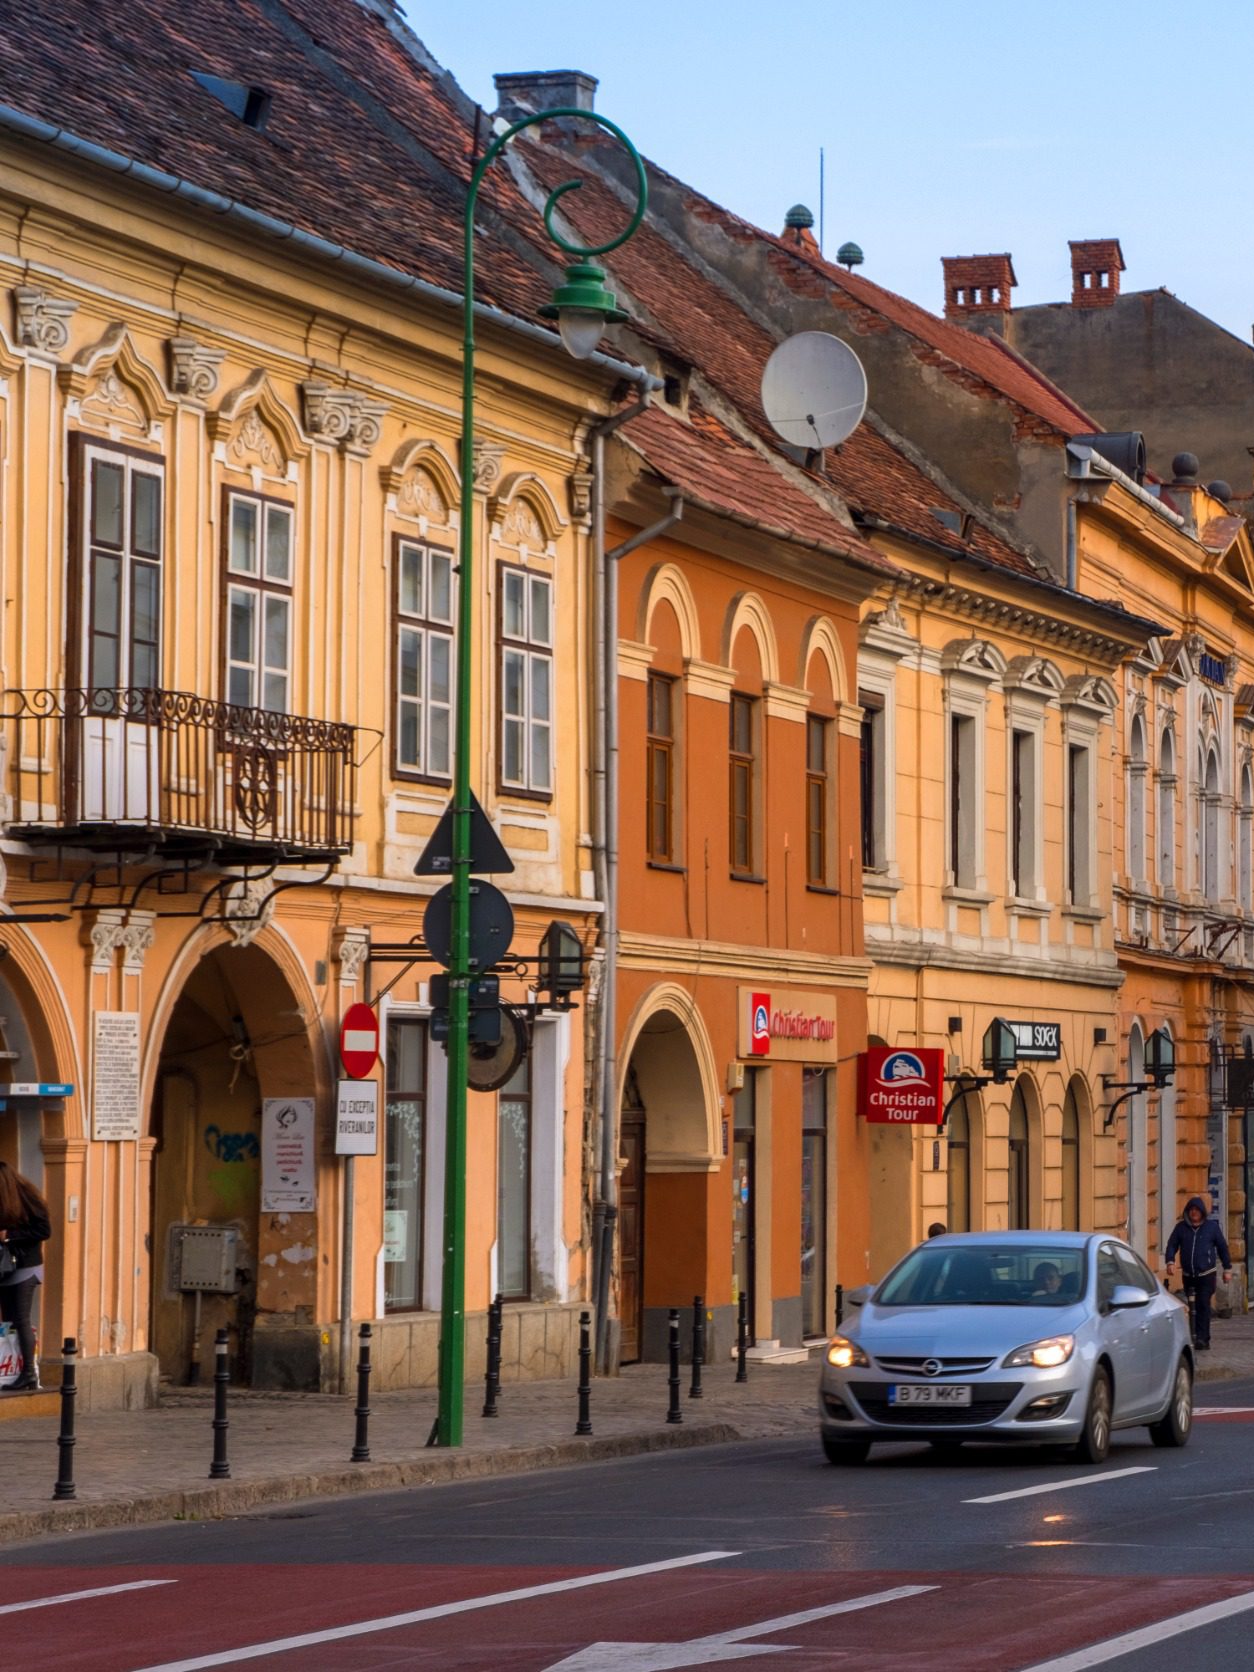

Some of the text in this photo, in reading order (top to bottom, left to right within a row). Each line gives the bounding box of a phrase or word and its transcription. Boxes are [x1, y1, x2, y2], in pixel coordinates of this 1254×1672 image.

[773, 1009, 835, 1039] Christian Tour
[870, 1091, 936, 1106] Christian
[886, 1107, 919, 1120] Tour
[900, 1386, 910, 1401] B
